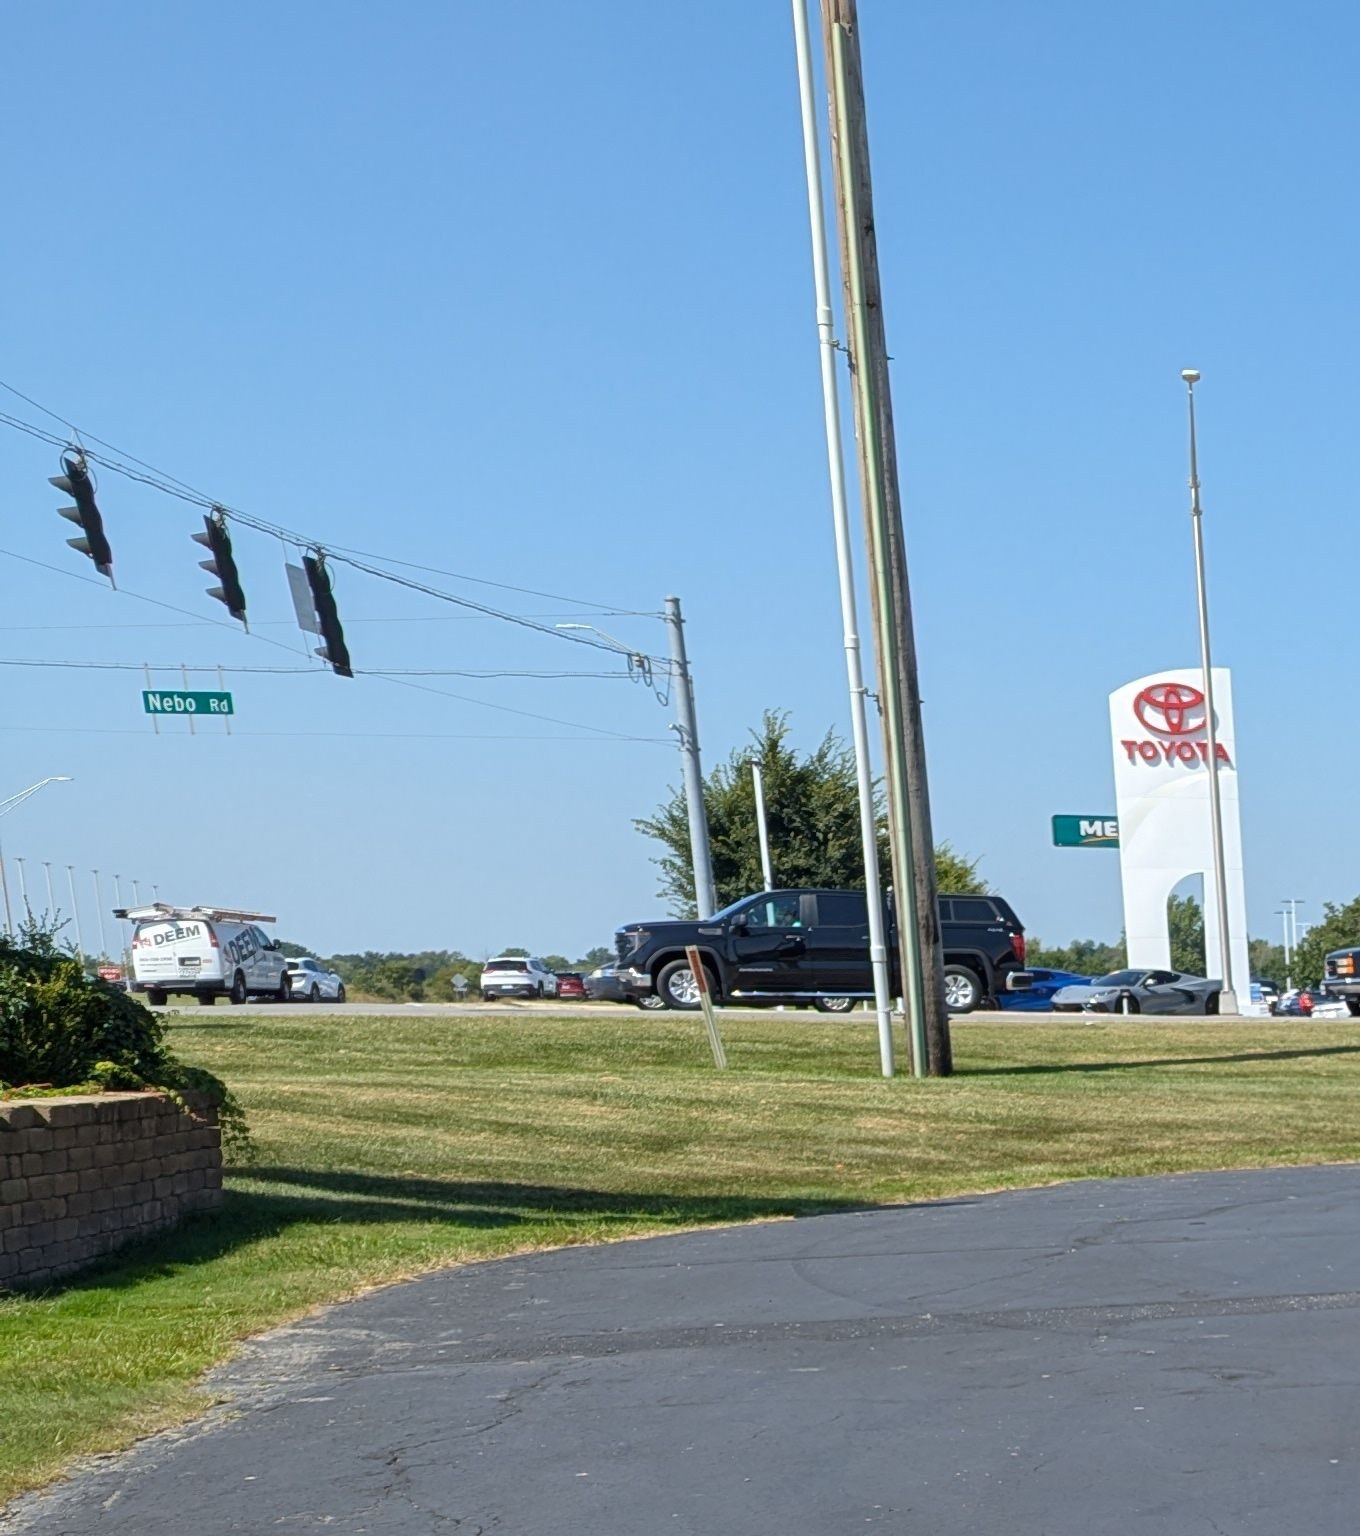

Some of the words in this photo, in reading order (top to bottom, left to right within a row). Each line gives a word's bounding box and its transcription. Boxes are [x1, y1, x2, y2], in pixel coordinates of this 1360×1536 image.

[147, 693, 196, 712] Nebo
[209, 698, 229, 712] Rd
[1120, 740, 1231, 763] TOYOTA
[153, 925, 200, 946] DEEM
